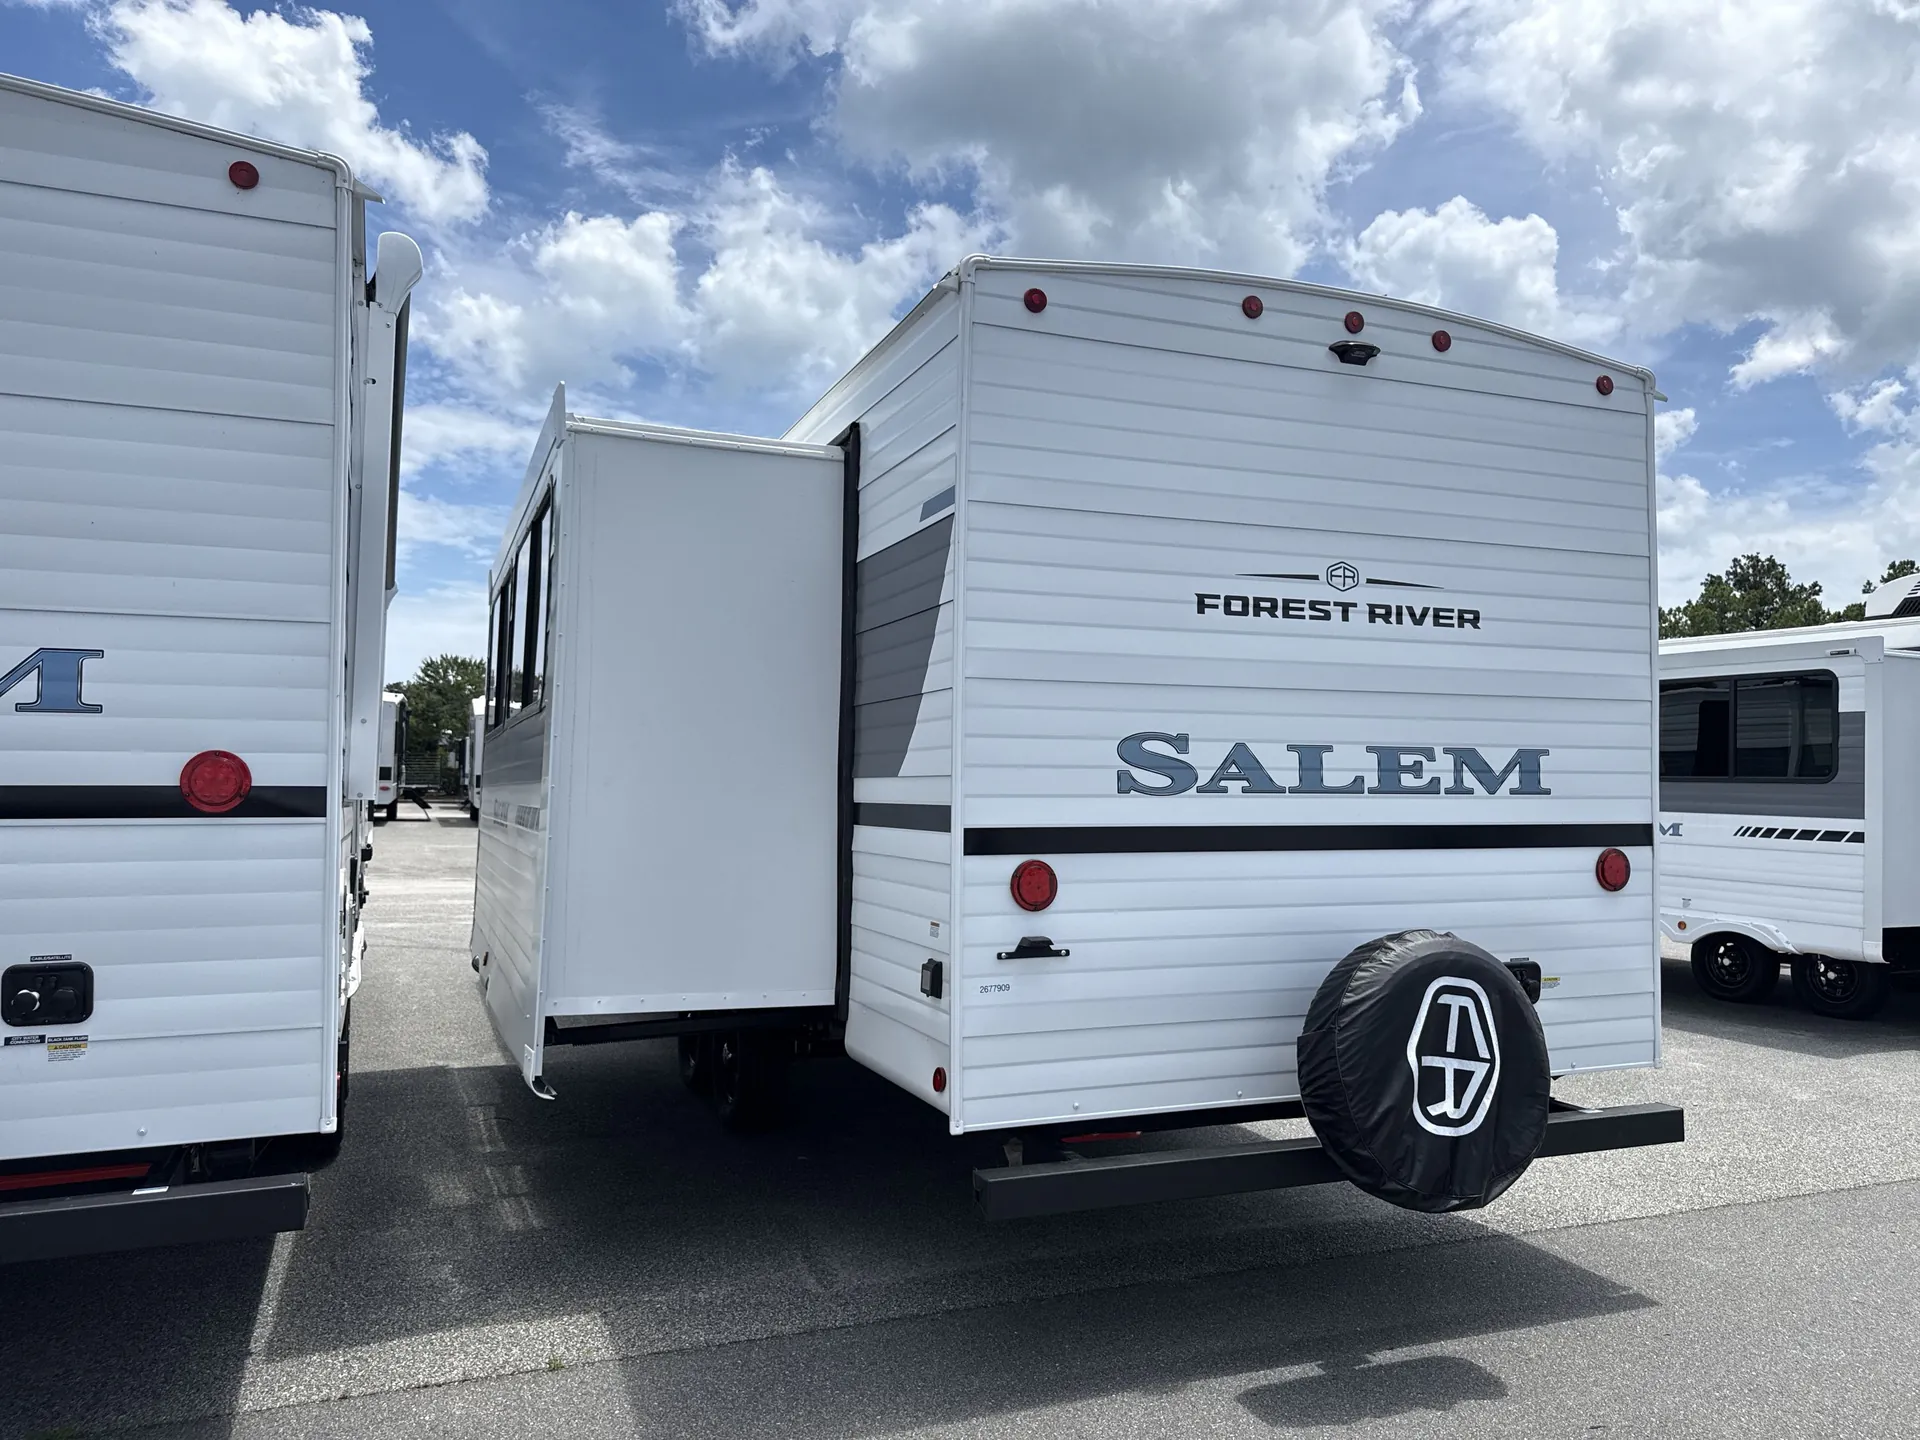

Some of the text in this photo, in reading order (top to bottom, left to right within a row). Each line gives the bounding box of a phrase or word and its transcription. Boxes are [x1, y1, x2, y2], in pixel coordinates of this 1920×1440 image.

[1329, 565, 1357, 588] FR
[1194, 592, 1482, 630] FOREST RIVER
[1116, 731, 1552, 797] SALEM
[979, 983, 1011, 994] 2677909
